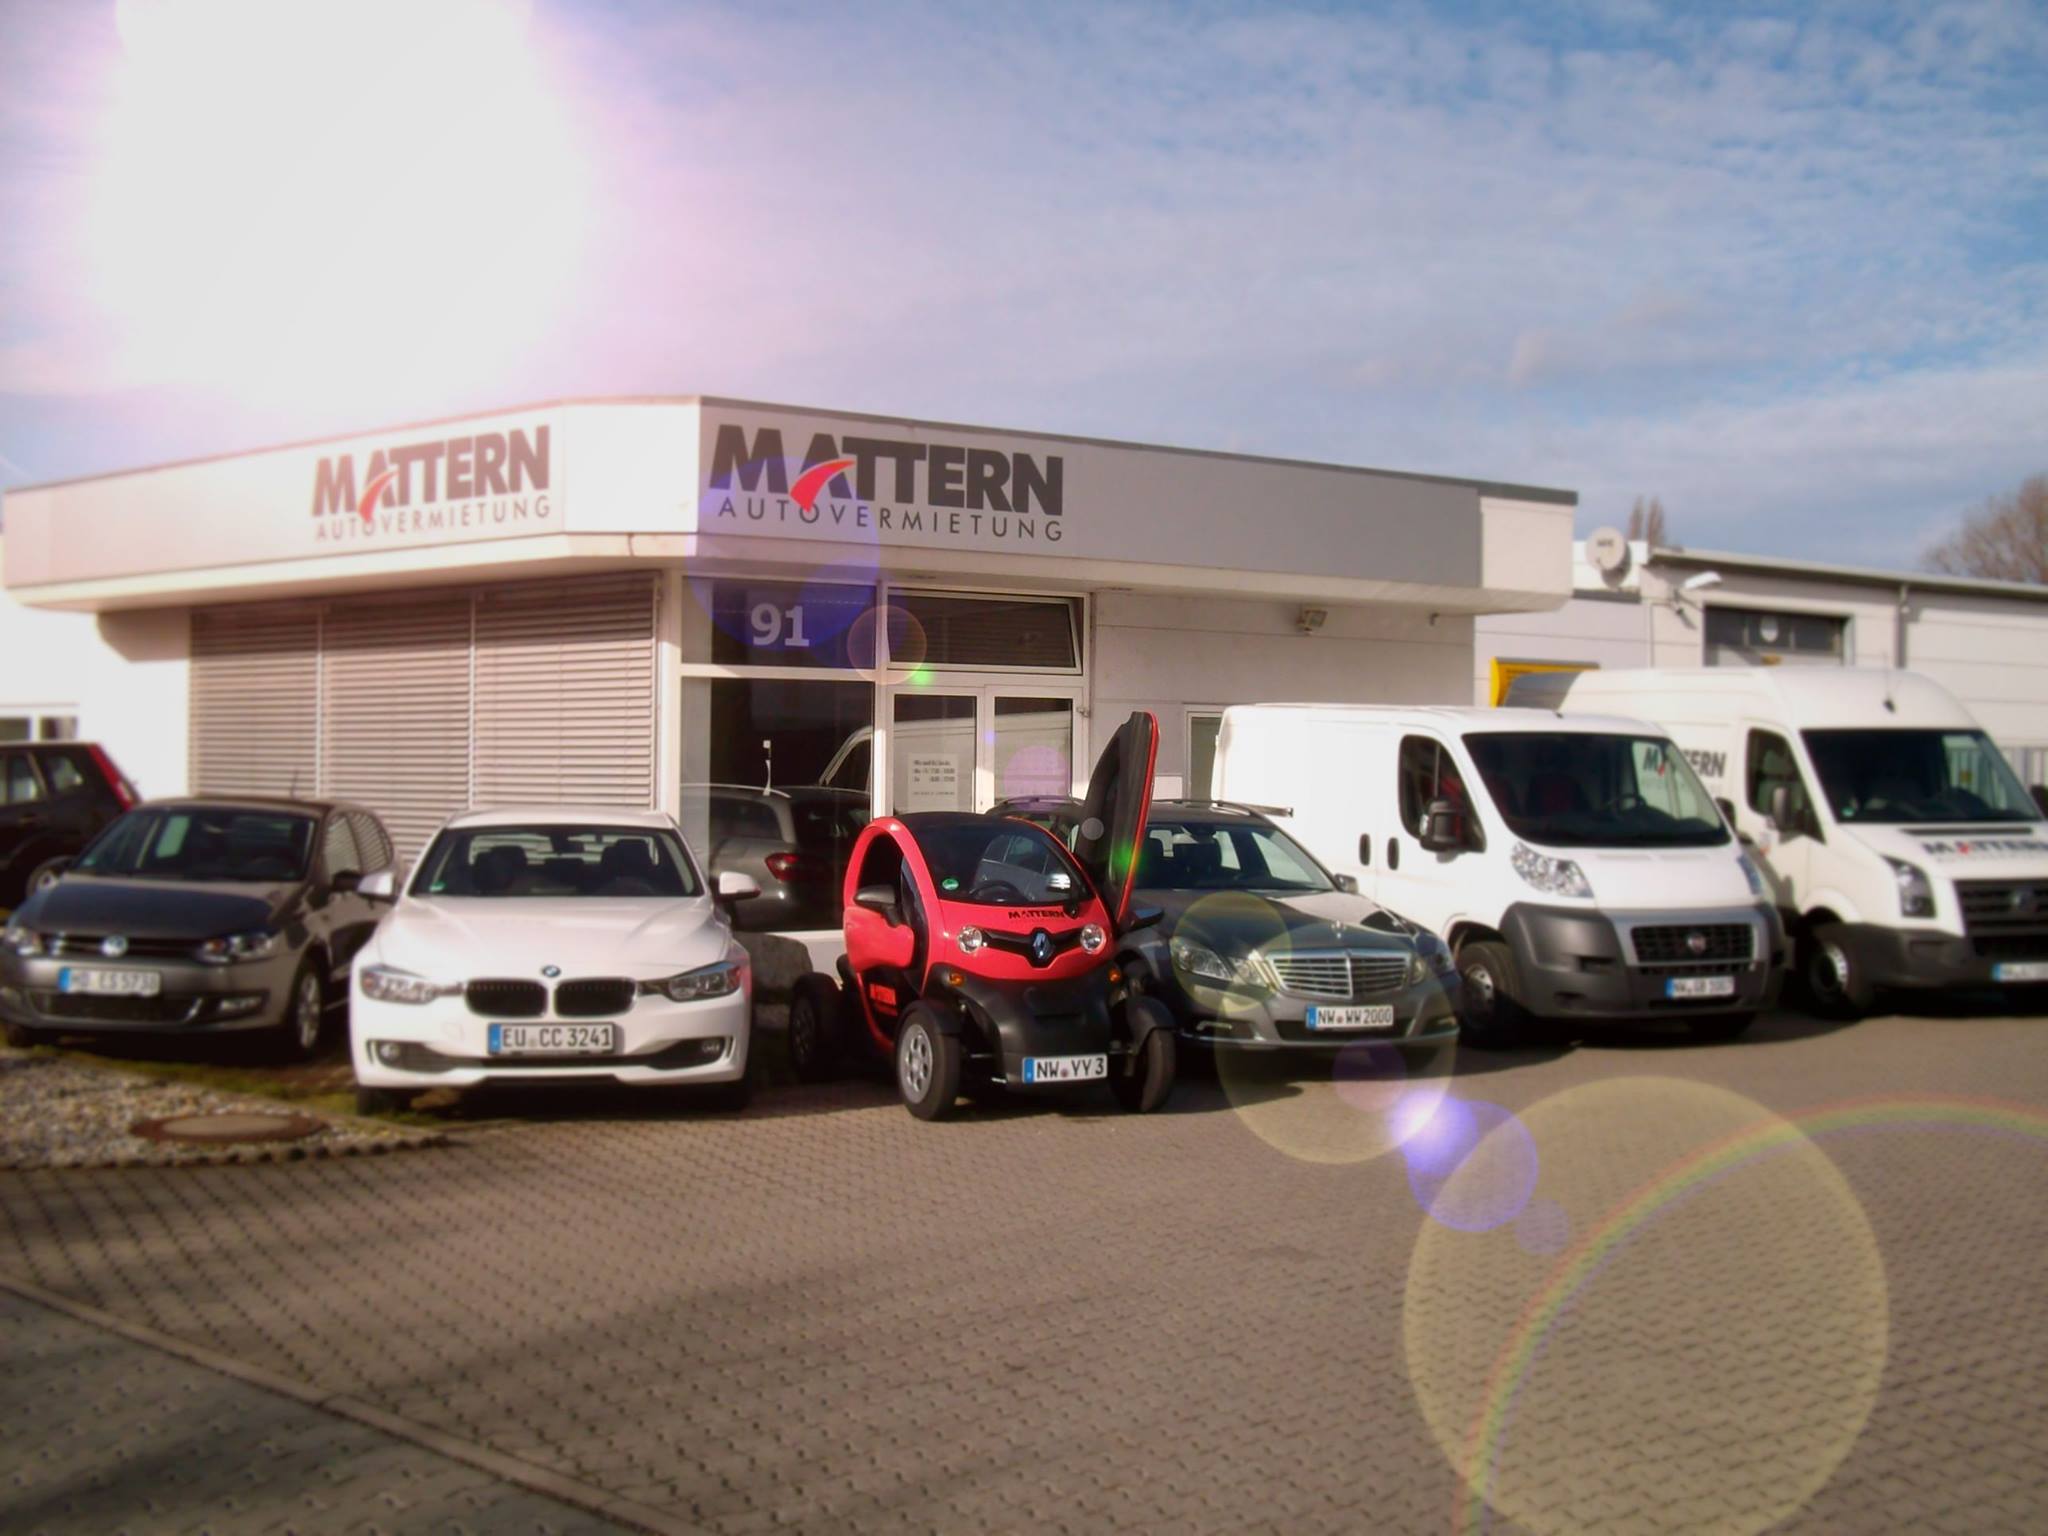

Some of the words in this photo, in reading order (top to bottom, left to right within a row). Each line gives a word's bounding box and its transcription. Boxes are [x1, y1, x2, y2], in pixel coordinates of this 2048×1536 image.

[312, 425, 550, 517] MATTERN
[709, 424, 1064, 516] MATTERN
[316, 495, 551, 541] AUTOVERMIETUNG
[718, 496, 1063, 541] AUTOVERMIETUNG
[751, 603, 810, 647] 91
[503, 1028, 526, 1047] EU
[540, 1028, 562, 1047] CC
[567, 1028, 611, 1047] 3241
[1037, 1060, 1060, 1078] NW
